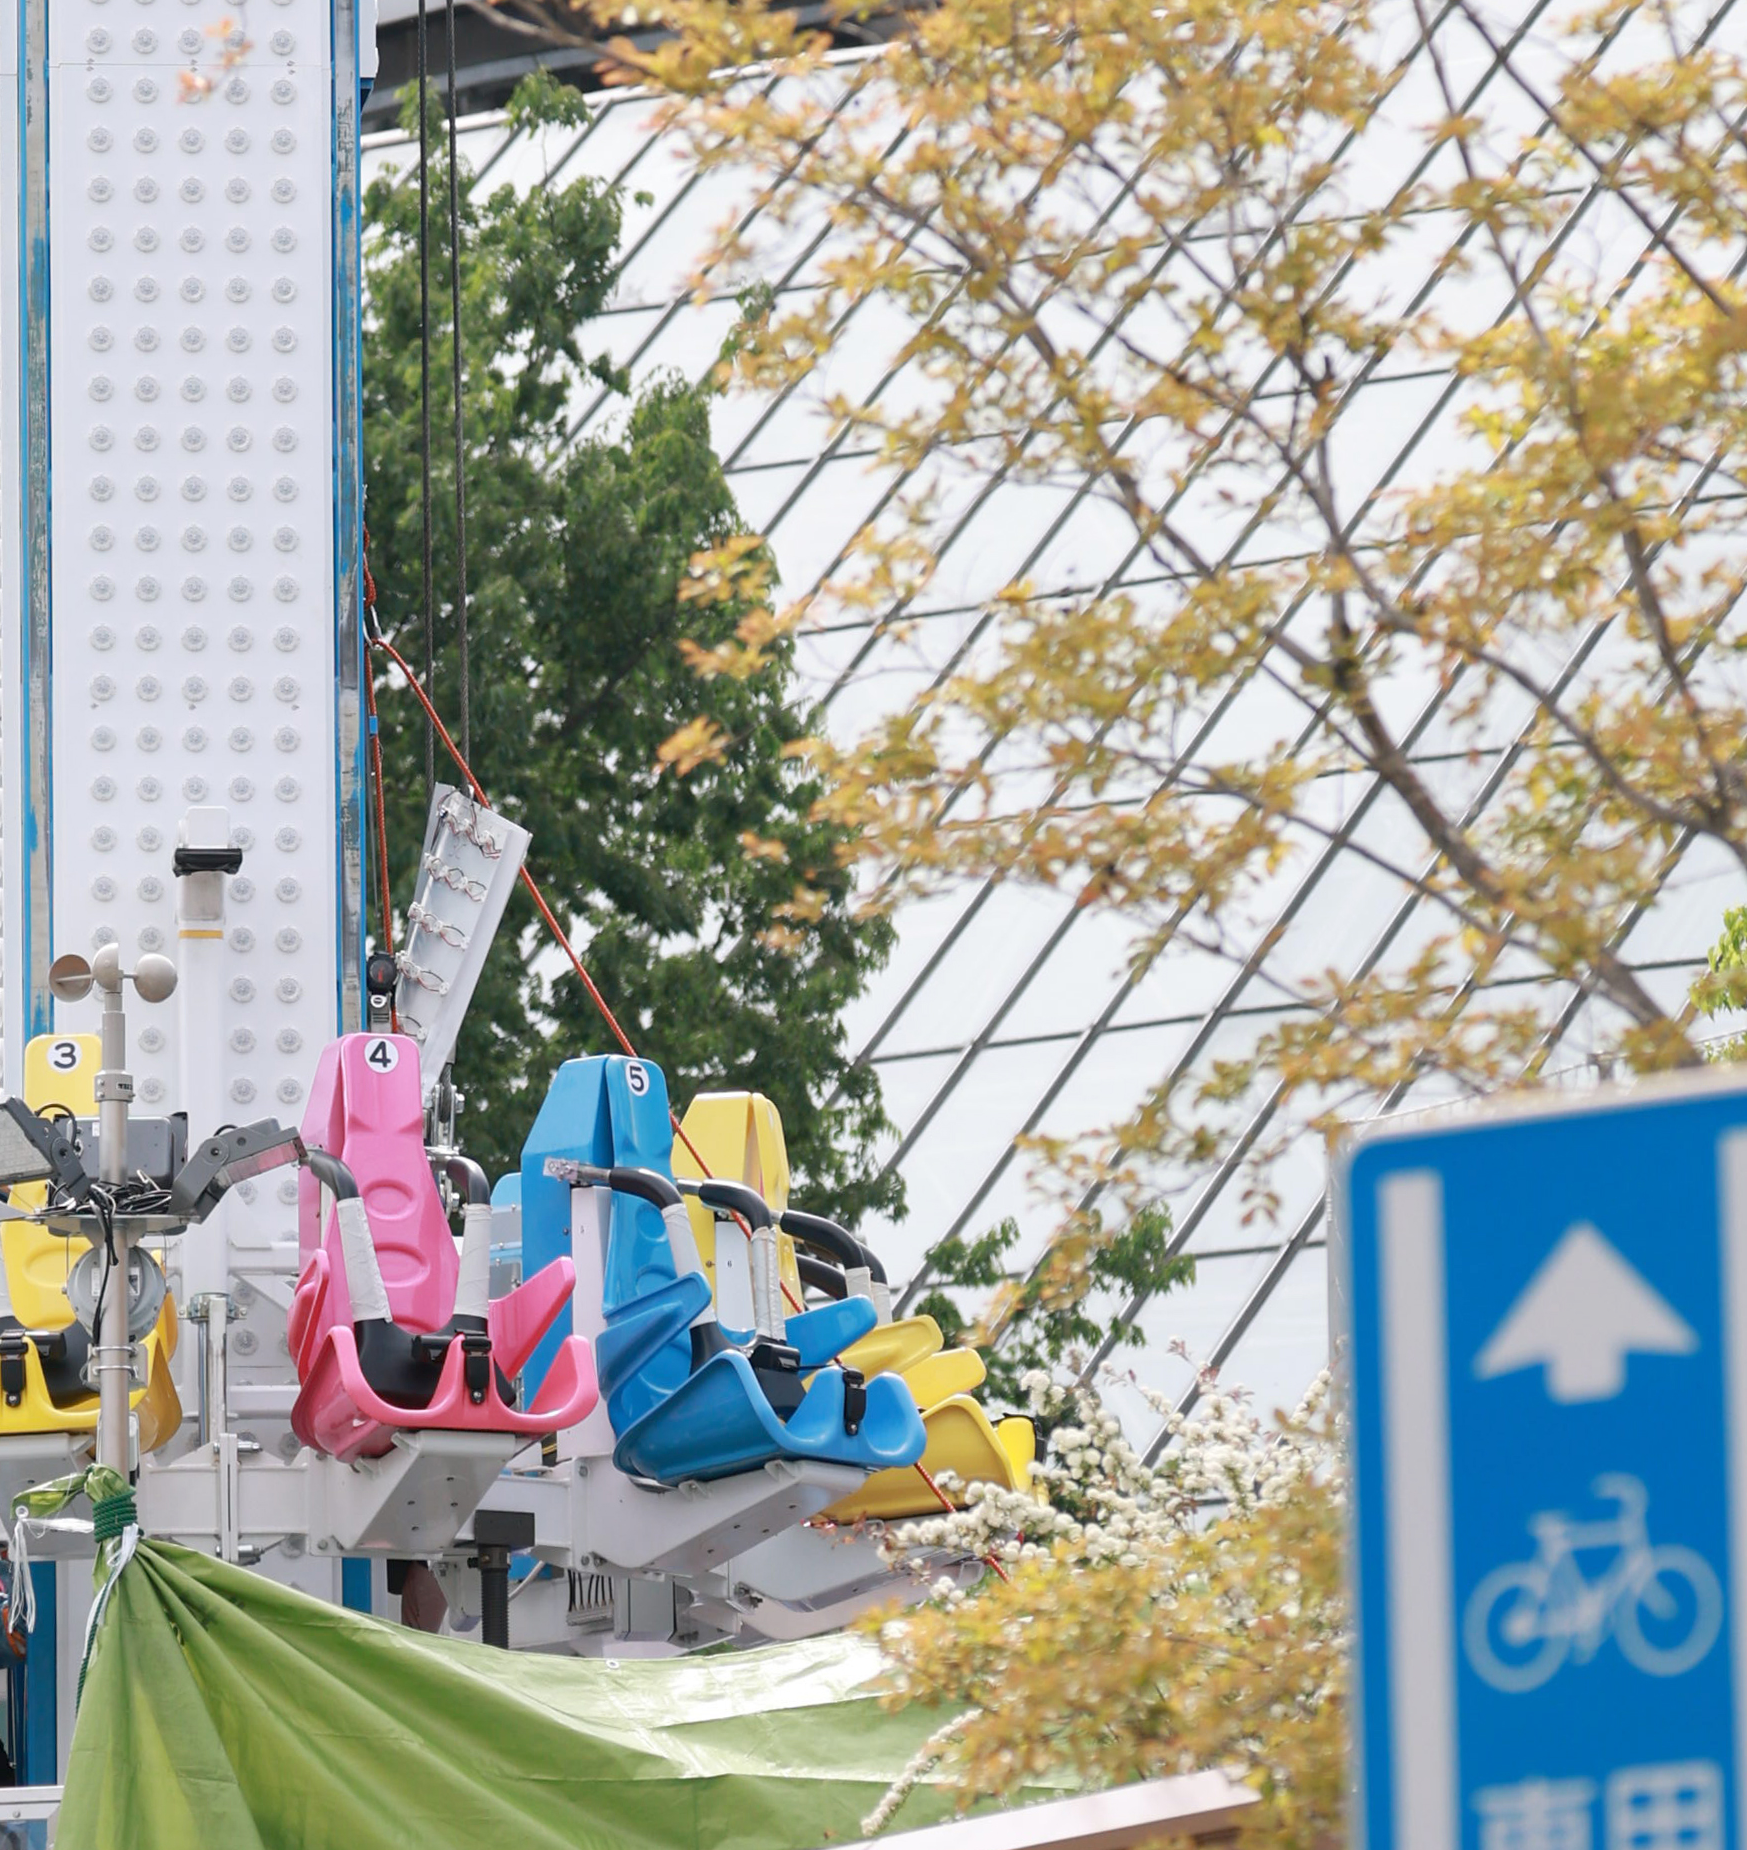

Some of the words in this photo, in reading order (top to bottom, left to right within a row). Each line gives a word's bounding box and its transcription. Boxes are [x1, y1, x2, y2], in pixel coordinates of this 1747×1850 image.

[54, 1042, 76, 1068] 3
[369, 1041, 392, 1068] 4
[629, 1066, 645, 1092] 5
